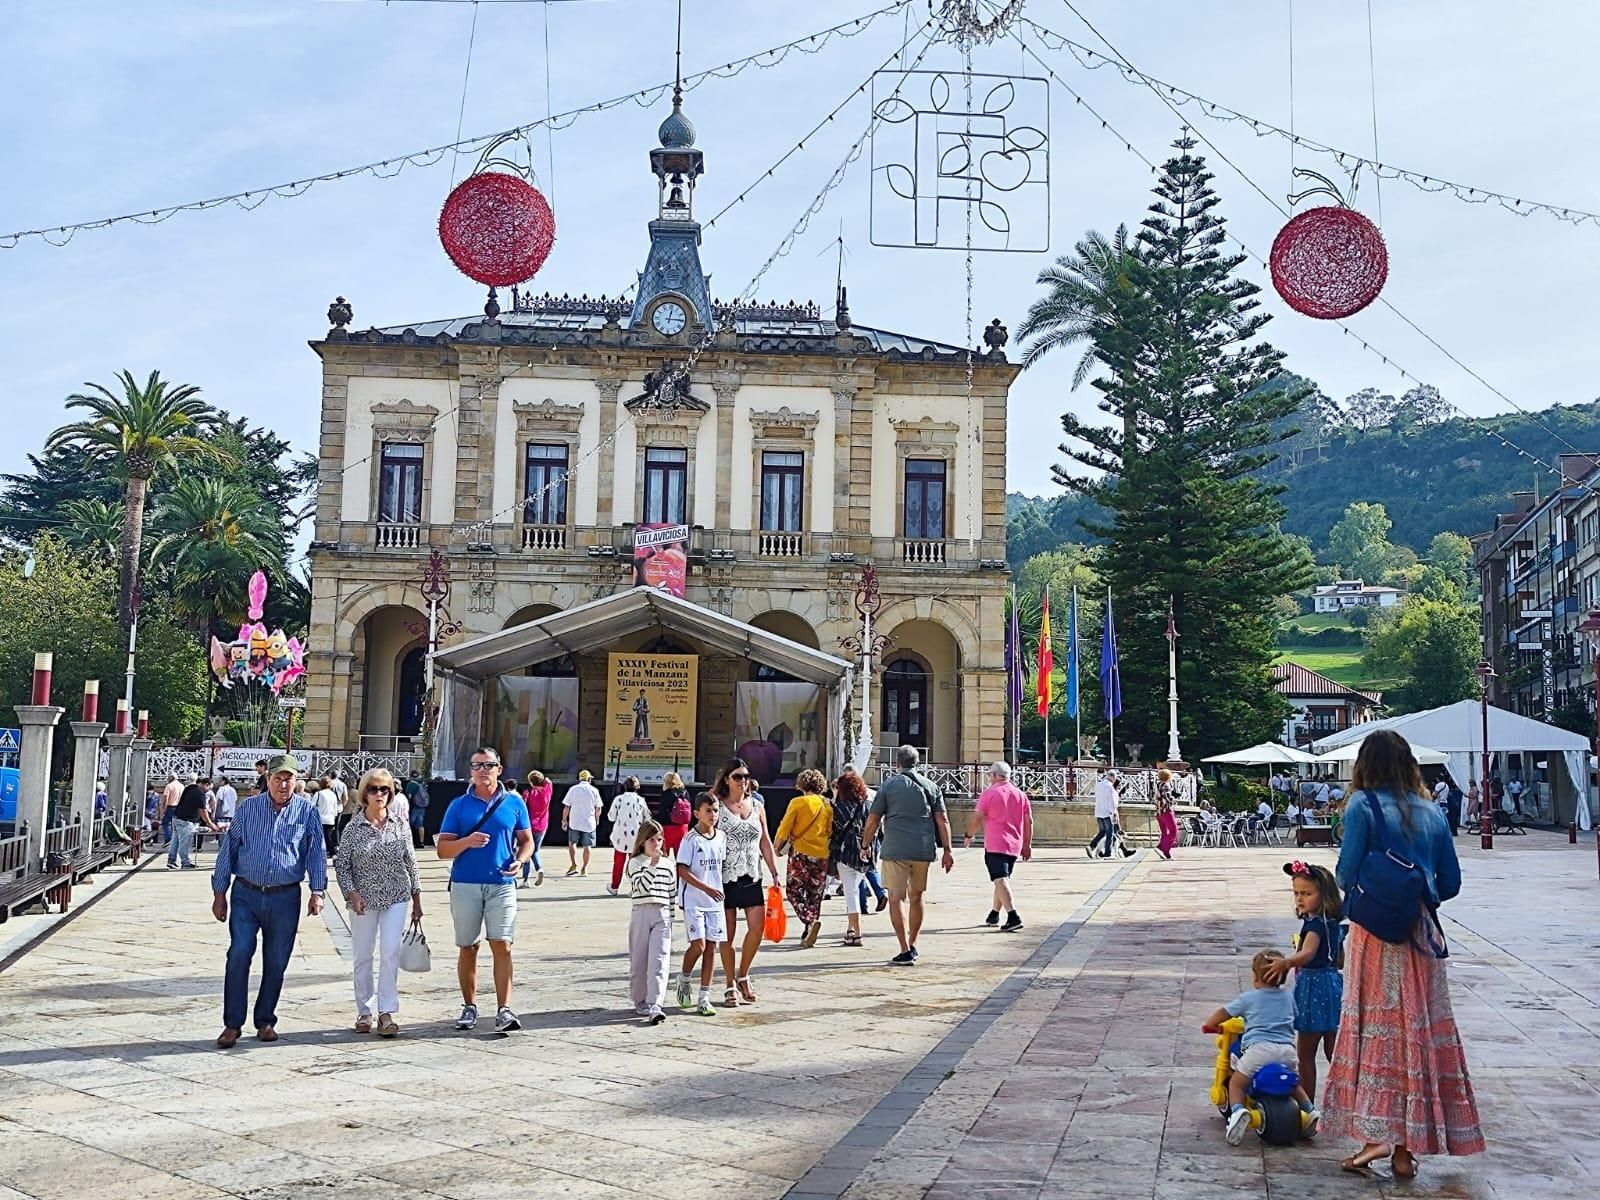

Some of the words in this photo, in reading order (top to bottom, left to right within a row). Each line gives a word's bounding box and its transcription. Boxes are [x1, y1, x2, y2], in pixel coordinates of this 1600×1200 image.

[637, 528, 686, 544] VILLAVICIOSA
[617, 660, 648, 668] XXXIV
[651, 660, 689, 669] Festival
[617, 669, 629, 677] de
[632, 669, 641, 677] la
[644, 670, 688, 678] Manzana
[617, 679, 664, 687] Villaviciosa
[221, 751, 262, 760] MERCADO
